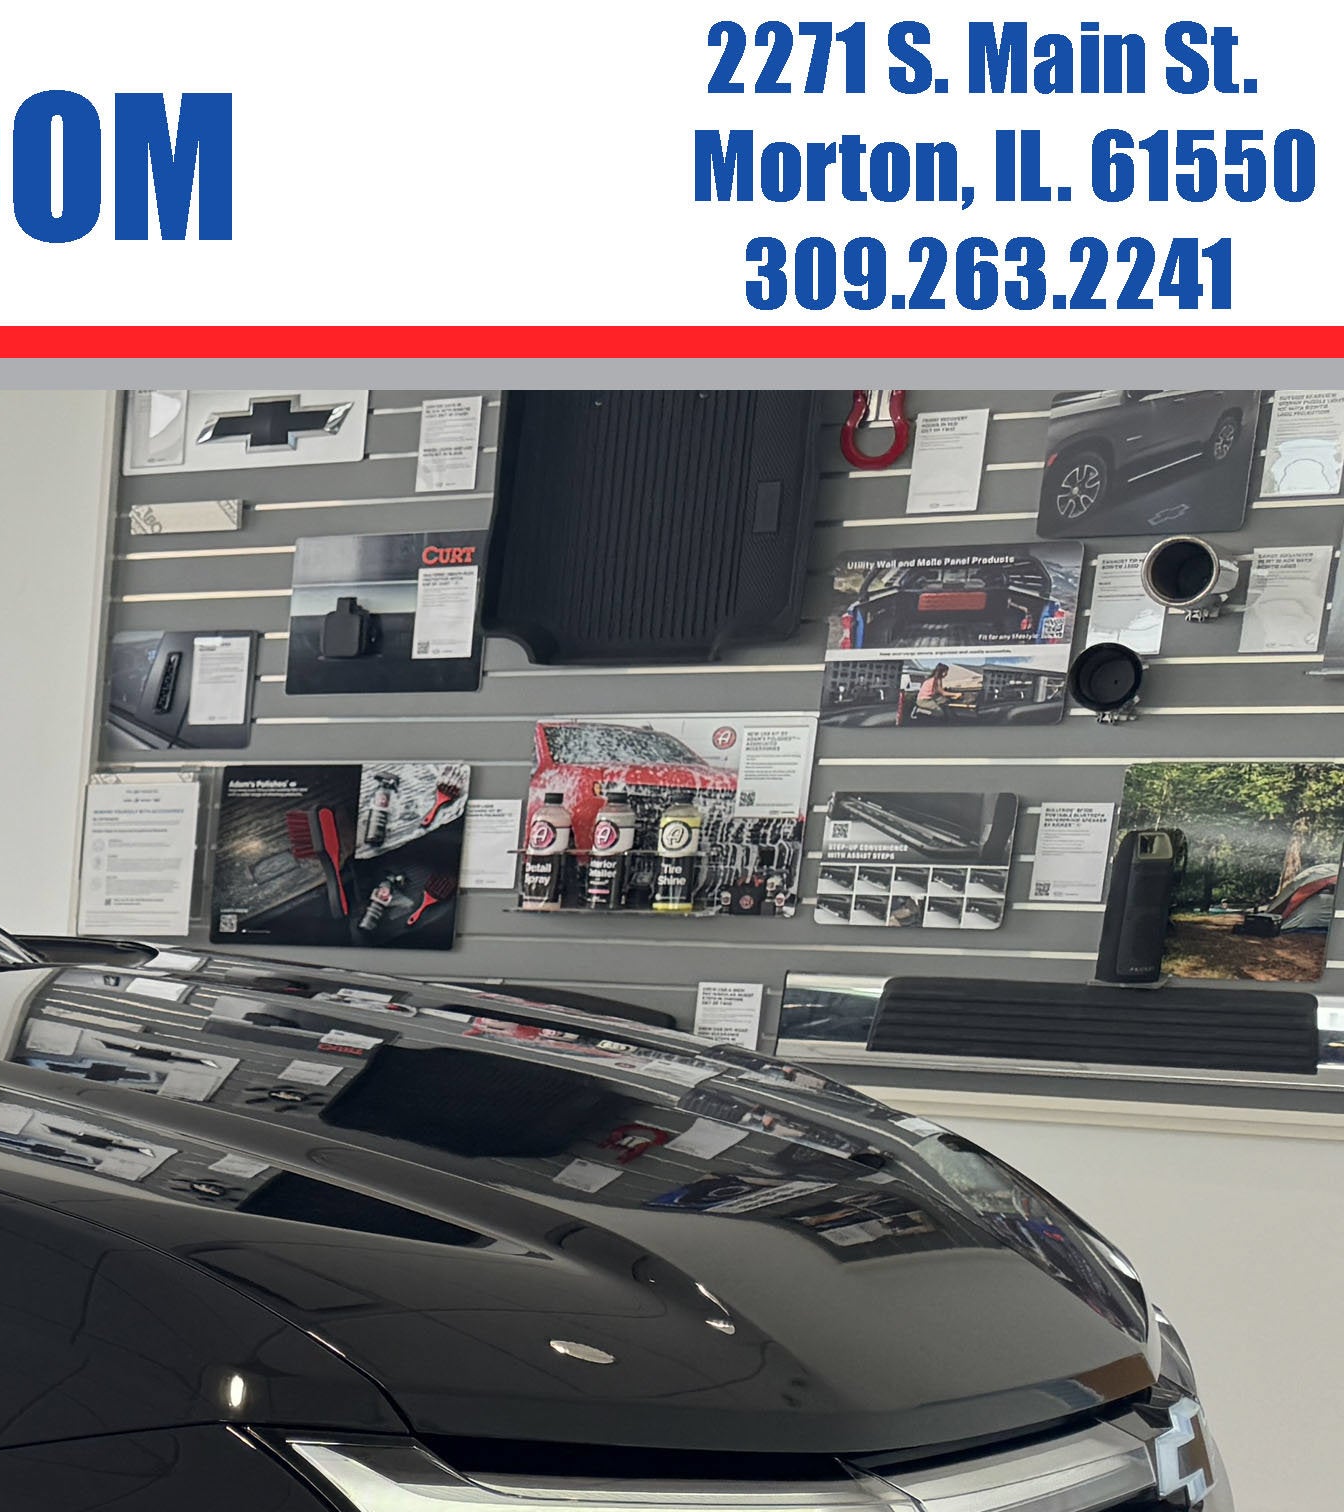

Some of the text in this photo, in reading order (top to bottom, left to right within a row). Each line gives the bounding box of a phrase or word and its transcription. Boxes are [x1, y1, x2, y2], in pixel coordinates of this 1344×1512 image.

[421, 545, 476, 566] CURT
[846, 561, 876, 570] Utility
[876, 559, 897, 569] Wall
[897, 559, 916, 569] and
[943, 556, 971, 566] Panel
[971, 555, 1016, 565] Products
[998, 633, 1011, 641] any
[525, 862, 552, 873] Detail
[662, 862, 683, 874] Tire
[656, 875, 687, 886] Shine
